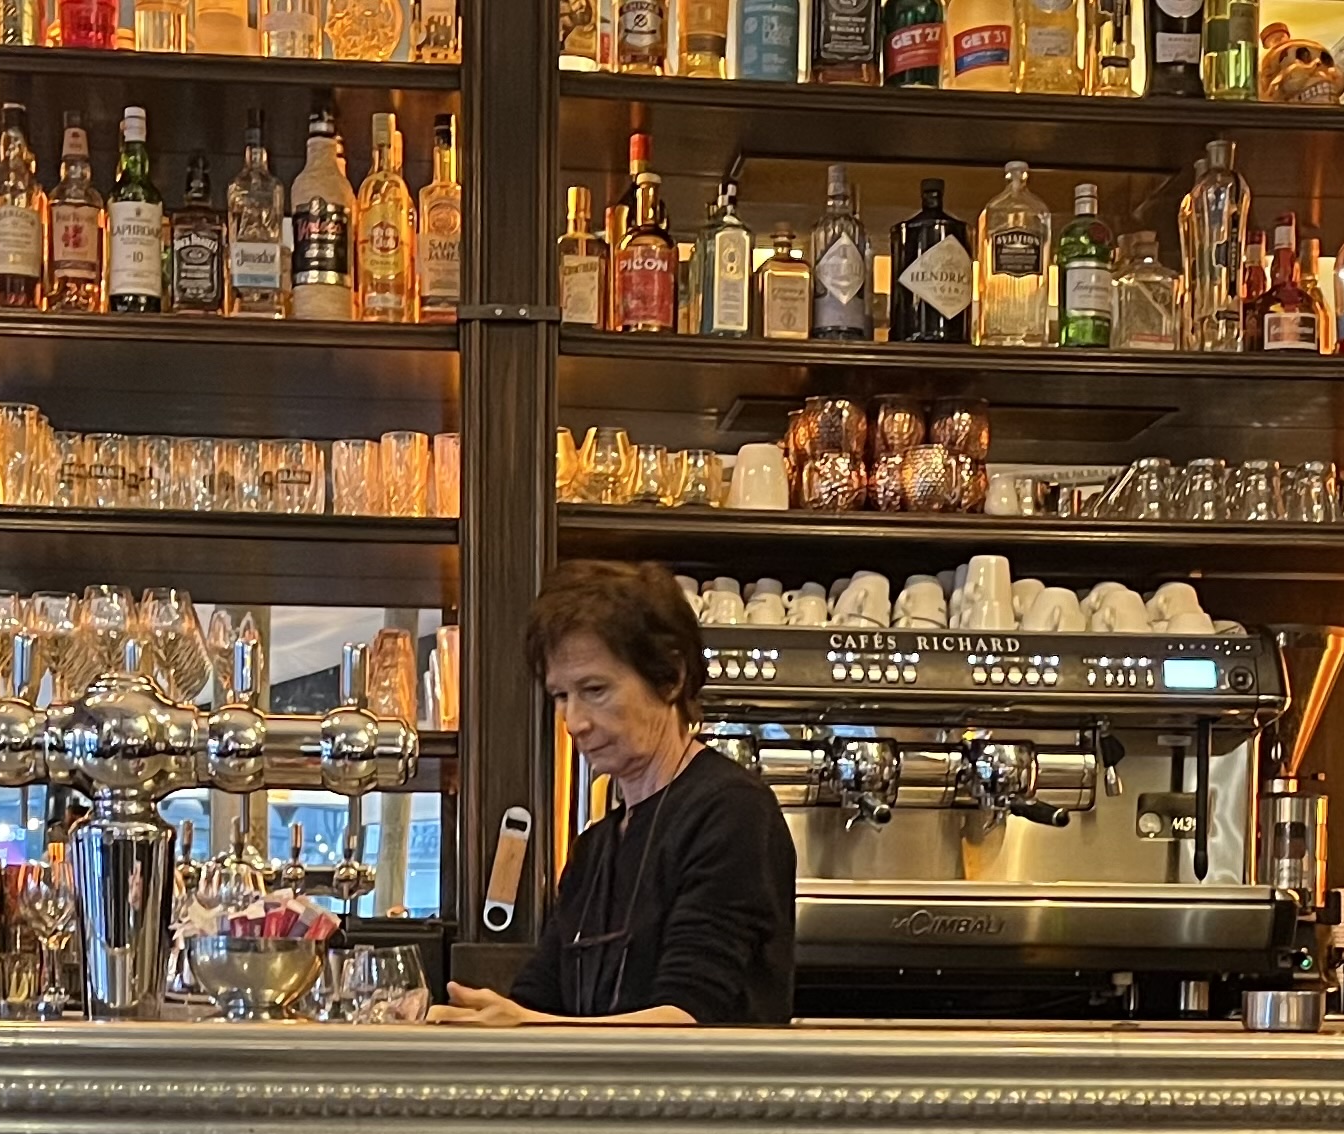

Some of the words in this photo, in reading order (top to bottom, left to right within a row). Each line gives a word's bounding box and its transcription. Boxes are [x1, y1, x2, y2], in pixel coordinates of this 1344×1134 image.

[891, 28, 923, 49] GET
[925, 26, 942, 42] 27
[961, 31, 992, 49] GET
[993, 30, 1006, 43] 31
[619, 258, 668, 272] PICON
[910, 271, 972, 286] HENDRIC
[829, 631, 898, 650] CAFÉS
[916, 635, 1021, 653] RICHARD
